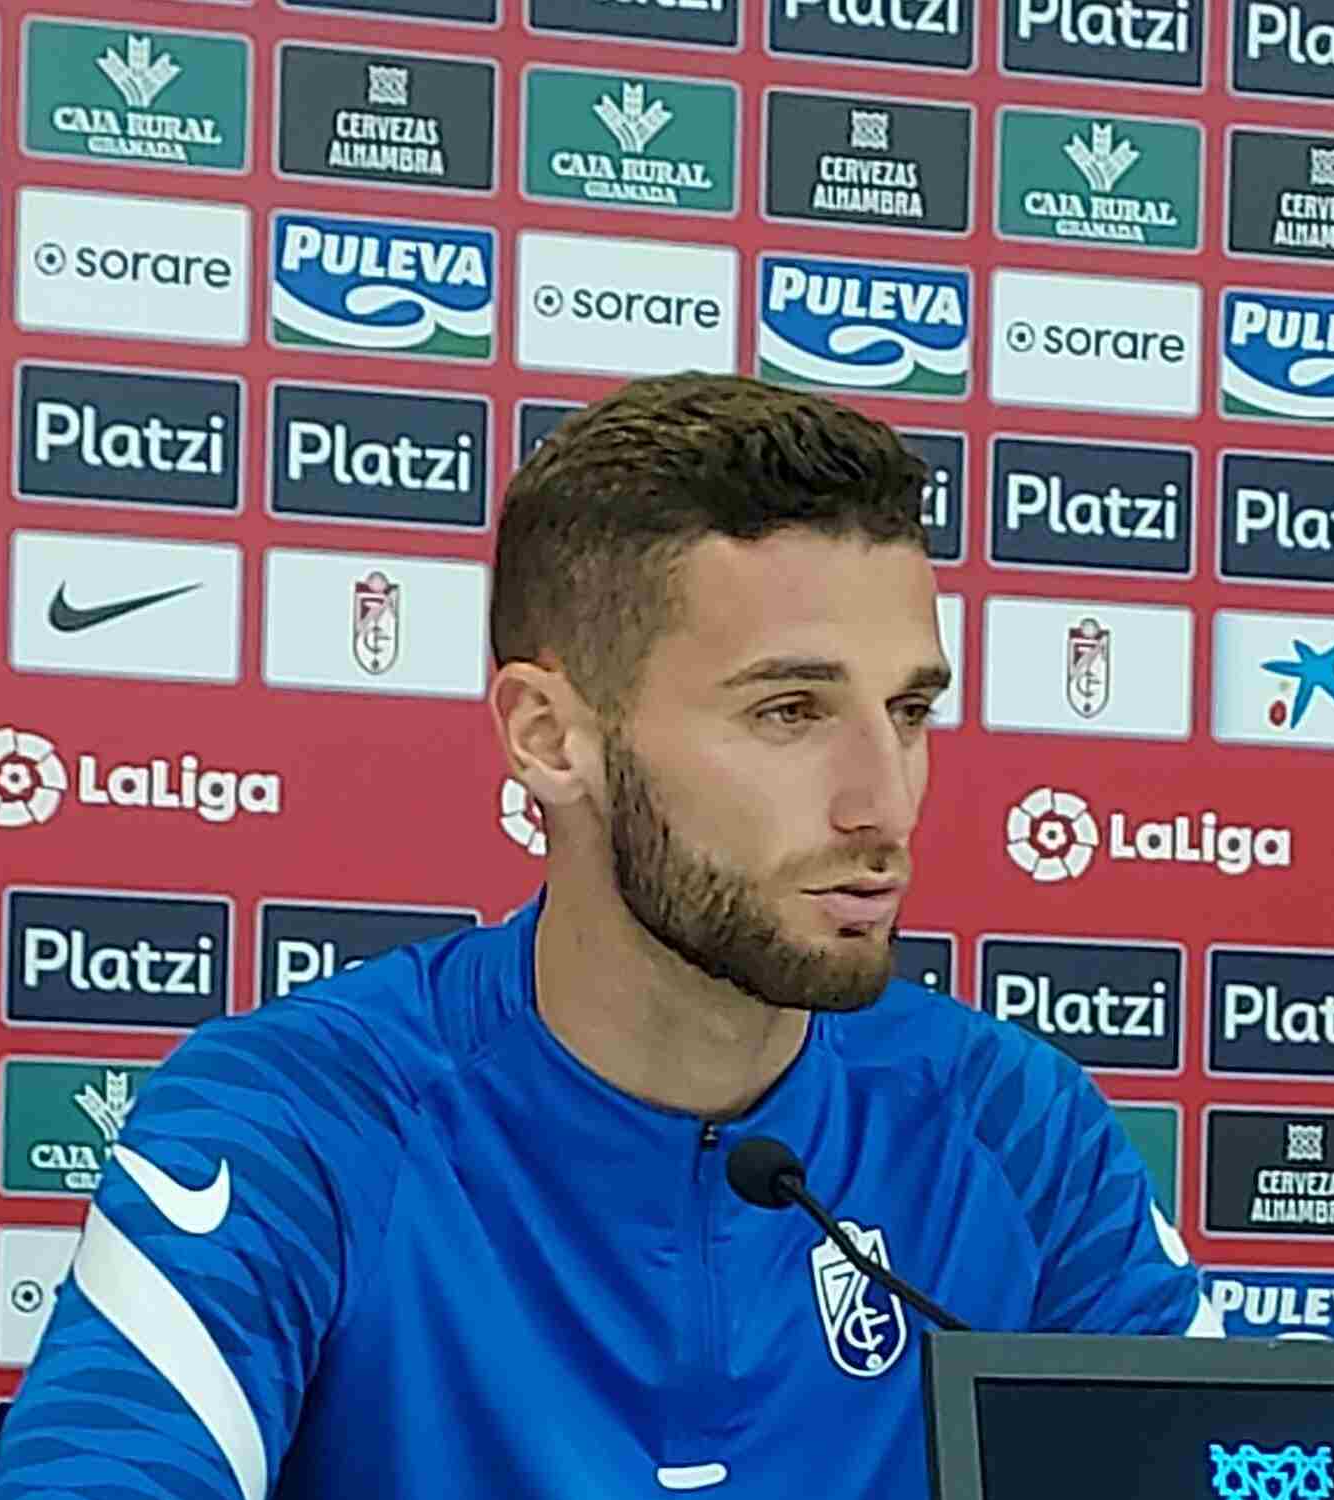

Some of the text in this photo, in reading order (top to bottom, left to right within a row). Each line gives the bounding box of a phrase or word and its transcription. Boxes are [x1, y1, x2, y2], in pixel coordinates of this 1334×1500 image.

[1019, 0, 1188, 52] Platzi
[53, 105, 222, 144] CAJA RURAL
[336, 111, 440, 145] CERVEZAS
[88, 136, 189, 162] GRANADA
[328, 140, 445, 175] ALHAMBRA
[551, 152, 713, 188] CAJA RURAL
[820, 155, 918, 189] CERVEZAS
[585, 181, 678, 205] GRANADA
[813, 182, 924, 219] ALHAMBRA
[1024, 191, 1178, 226] CAJA RURAL
[1056, 220, 1145, 244] GRANADA
[76, 248, 231, 288] sorare
[282, 225, 486, 286] PULEVA
[572, 289, 720, 328] sorare
[769, 266, 962, 325] PULEVA
[1043, 326, 1184, 363] sorare
[37, 403, 223, 473] Platzi
[289, 422, 470, 491] Platzi
[1008, 474, 1177, 539] Platzi
[80, 756, 280, 821] LaLiga
[1110, 813, 1290, 874] LaLiga
[25, 928, 211, 994] Platzi
[996, 974, 1166, 1037] Platzi
[30, 1144, 101, 1171] CAJA
